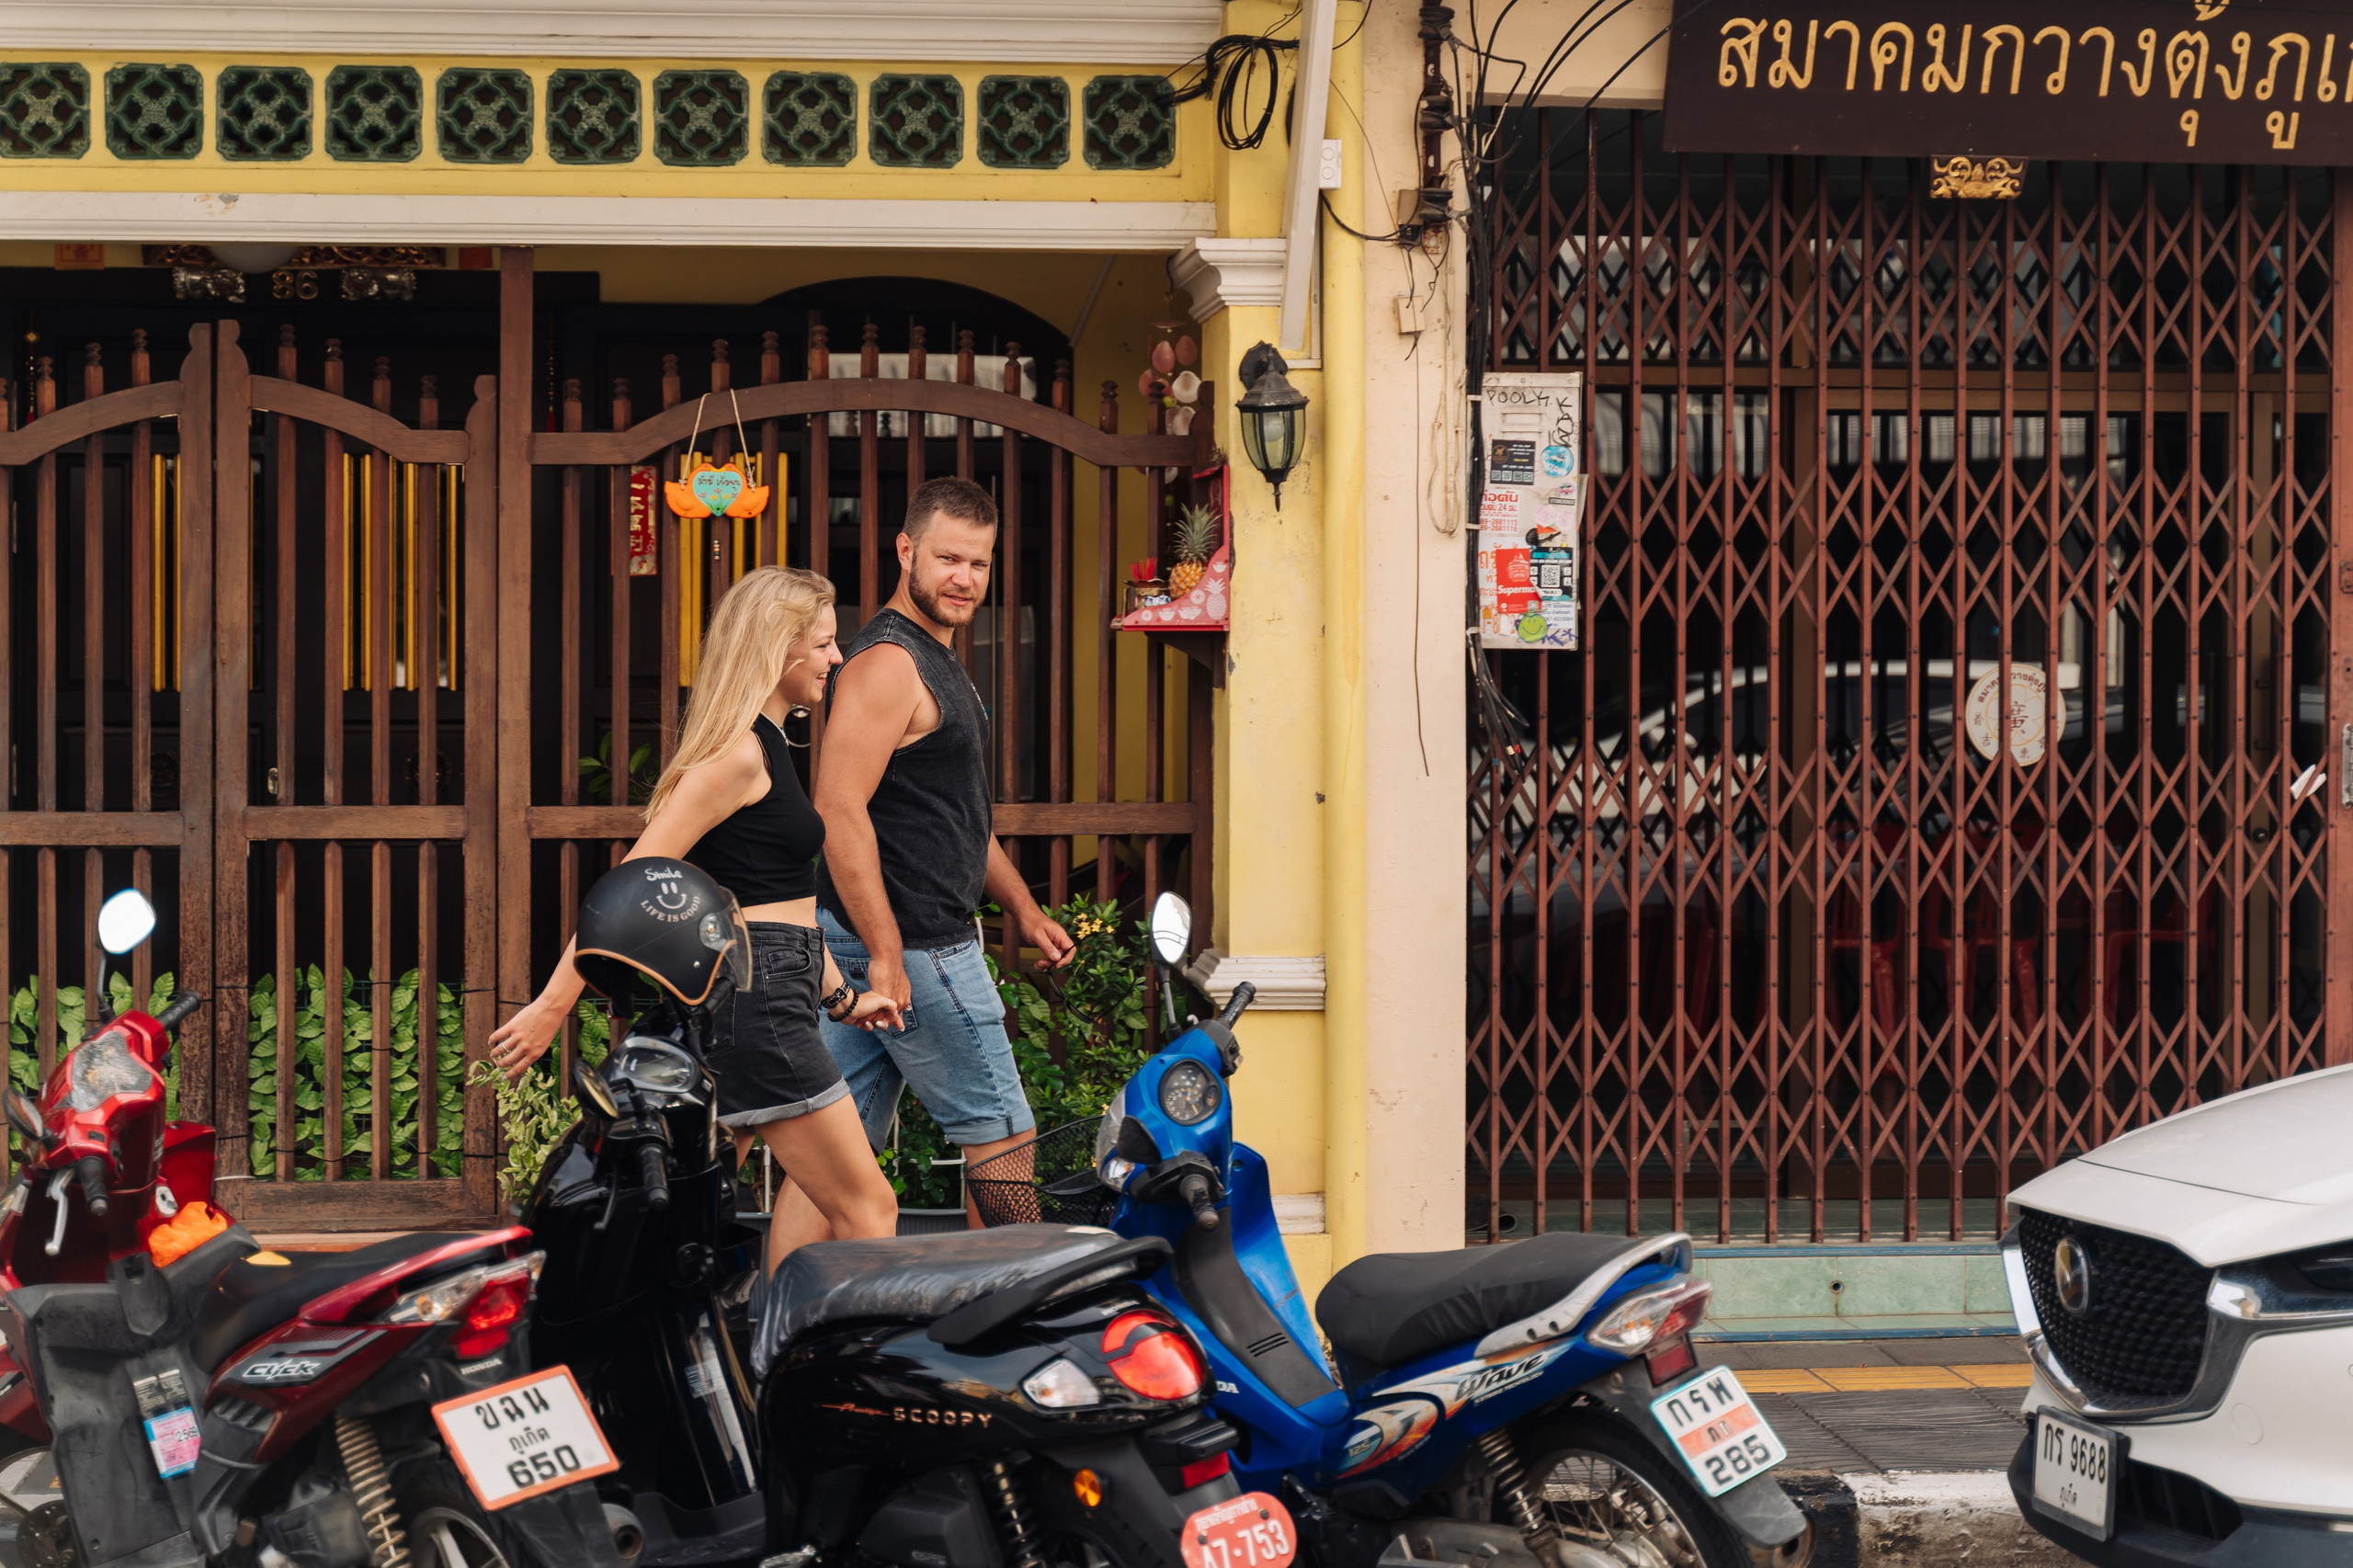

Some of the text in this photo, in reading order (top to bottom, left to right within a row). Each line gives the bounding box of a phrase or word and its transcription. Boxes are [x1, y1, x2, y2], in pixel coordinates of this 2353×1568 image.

[1719, 0, 2353, 150] สมาคมกวางตุ้งภูเ
[272, 270, 319, 301] 86
[644, 867, 683, 881] Smile
[641, 895, 700, 923] LIFE IS GOOD
[460, 1358, 503, 1375] HONDA
[1456, 1351, 1548, 1402] Wave
[474, 1386, 551, 1430] ขฉน
[892, 1406, 993, 1429] SCOOPY
[506, 1444, 582, 1489] 650
[1704, 1434, 1771, 1486] 285
[2044, 1423, 2107, 1484] กร 9688
